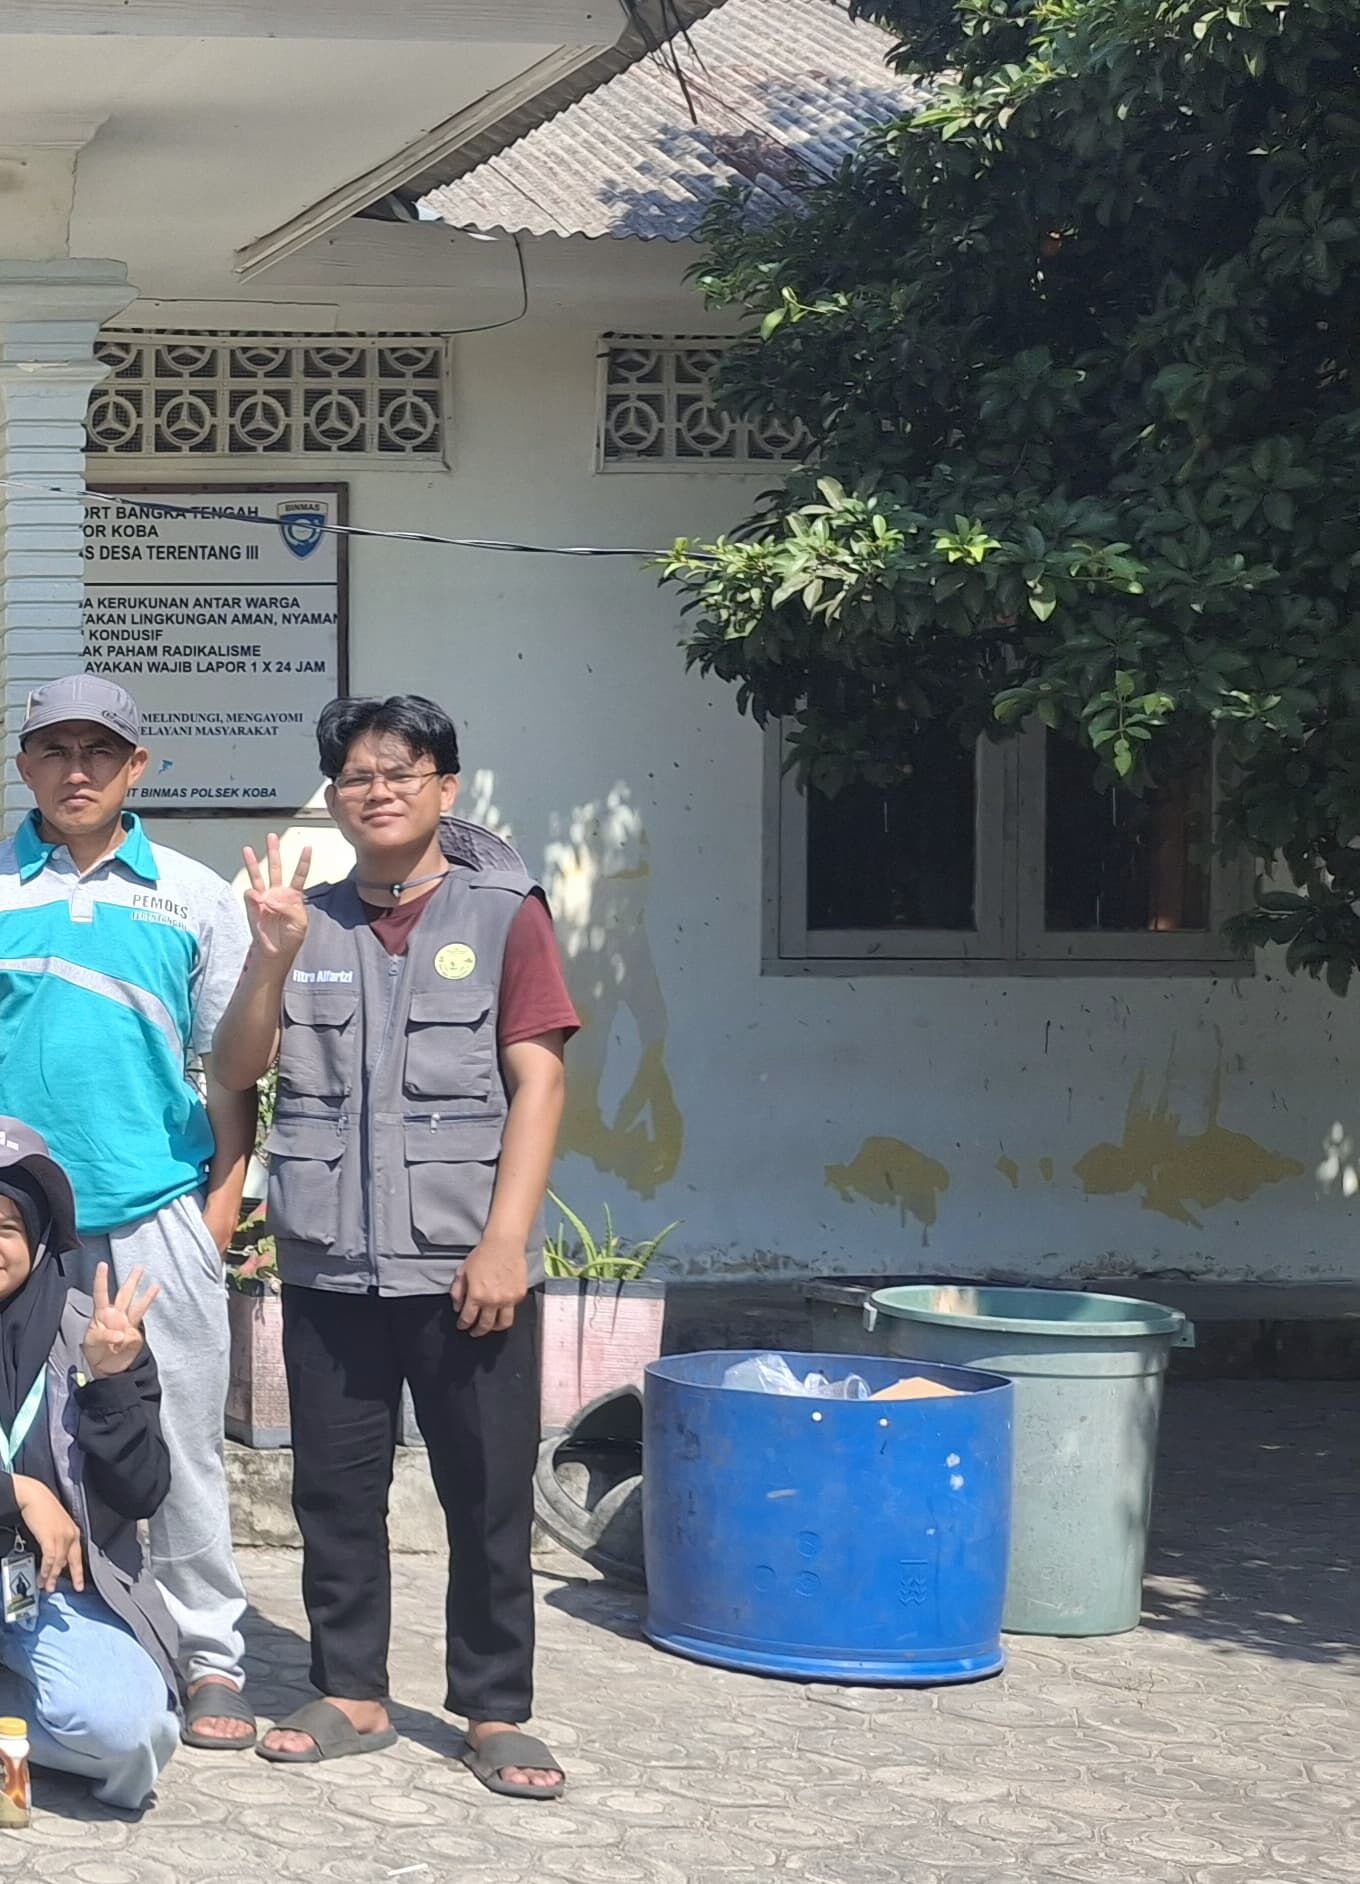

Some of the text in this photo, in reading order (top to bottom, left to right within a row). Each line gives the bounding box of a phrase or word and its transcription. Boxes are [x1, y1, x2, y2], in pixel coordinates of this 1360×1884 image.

[116, 505, 186, 519] BANGKA
[111, 524, 159, 537] KOBA
[99, 545, 142, 560] DESA
[146, 545, 242, 560] TERENTANG
[245, 545, 259, 560] III
[98, 597, 189, 608] KERUKUNAN
[192, 597, 241, 608] ANTAR
[245, 597, 300, 608] WARGA
[131, 613, 227, 625] LINGKUNGAN
[230, 613, 278, 627] AMAN,
[89, 629, 163, 641] KONDUSIF
[106, 645, 158, 657] PAHAM
[162, 645, 262, 657] RADIKALISME
[147, 661, 192, 673] WAJIB
[196, 661, 247, 673] LAPOR
[250, 661, 257, 673] 1
[261, 661, 272, 673] X
[275, 661, 292, 673] 24
[295, 661, 326, 673] JAM
[226, 713, 304, 723] MENGAYOMI
[195, 726, 280, 736] MASYARAKAT
[140, 787, 188, 798] BINMAS
[190, 787, 240, 798] POLSEK
[242, 787, 278, 798] KOBA
[131, 894, 189, 919] PEMDES
